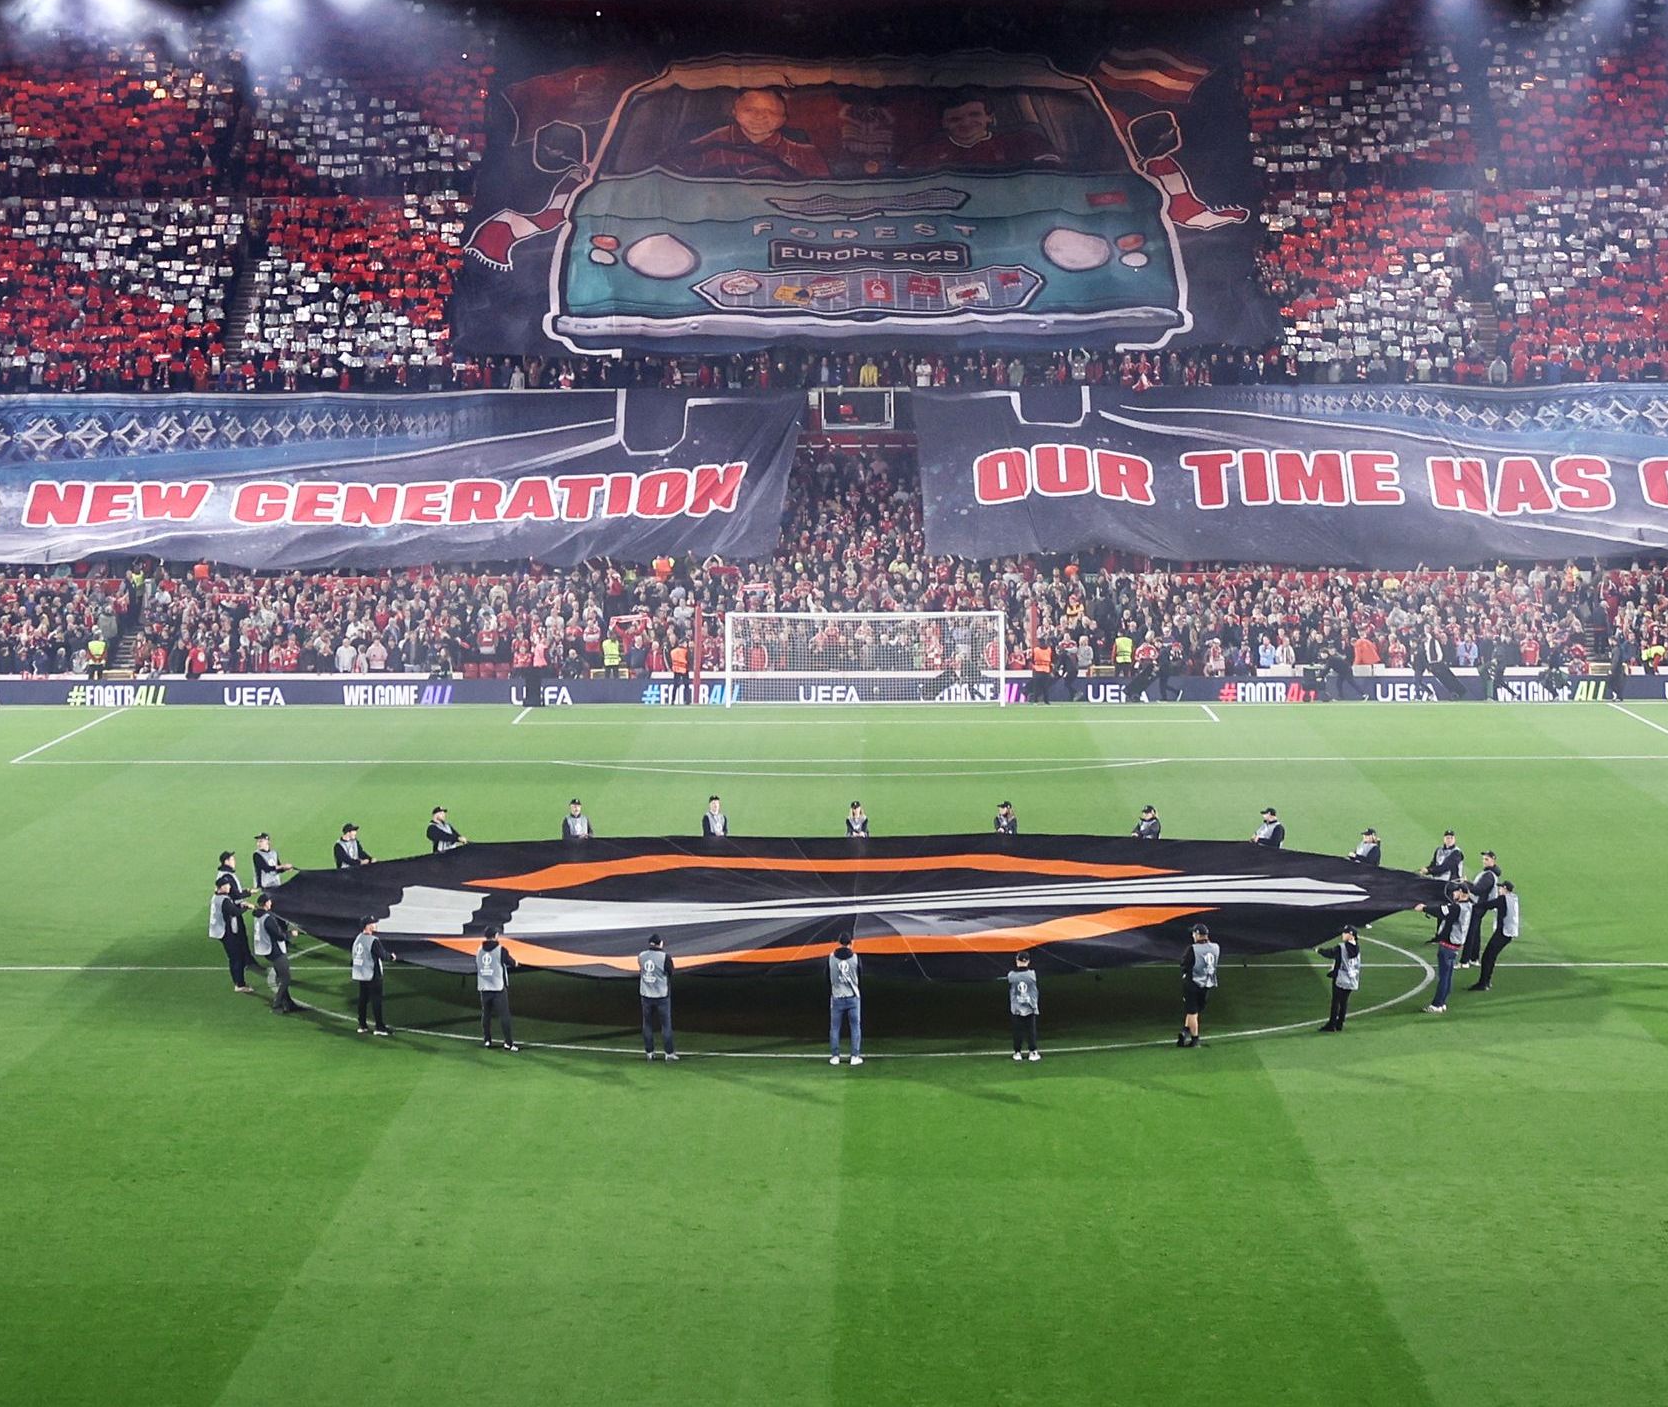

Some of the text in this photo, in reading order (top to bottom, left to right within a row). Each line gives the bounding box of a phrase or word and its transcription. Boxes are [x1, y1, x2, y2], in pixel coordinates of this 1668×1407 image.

[752, 222, 977, 239] FOREST
[781, 247, 959, 262] EUROPE 2025
[973, 444, 1155, 506] OUR
[1178, 444, 1406, 510] TIME
[1425, 454, 1617, 517] HAS
[22, 480, 213, 528] NEW
[232, 461, 748, 527] GENERATION
[66, 685, 166, 706] #FOOTBALL
[224, 687, 286, 706] UEFA
[343, 685, 452, 706] WELCOME ALL
[511, 686, 572, 706] UFA
[799, 685, 860, 703] UEFA
[919, 683, 994, 702] LCOME
[1573, 680, 1606, 701] ALL
